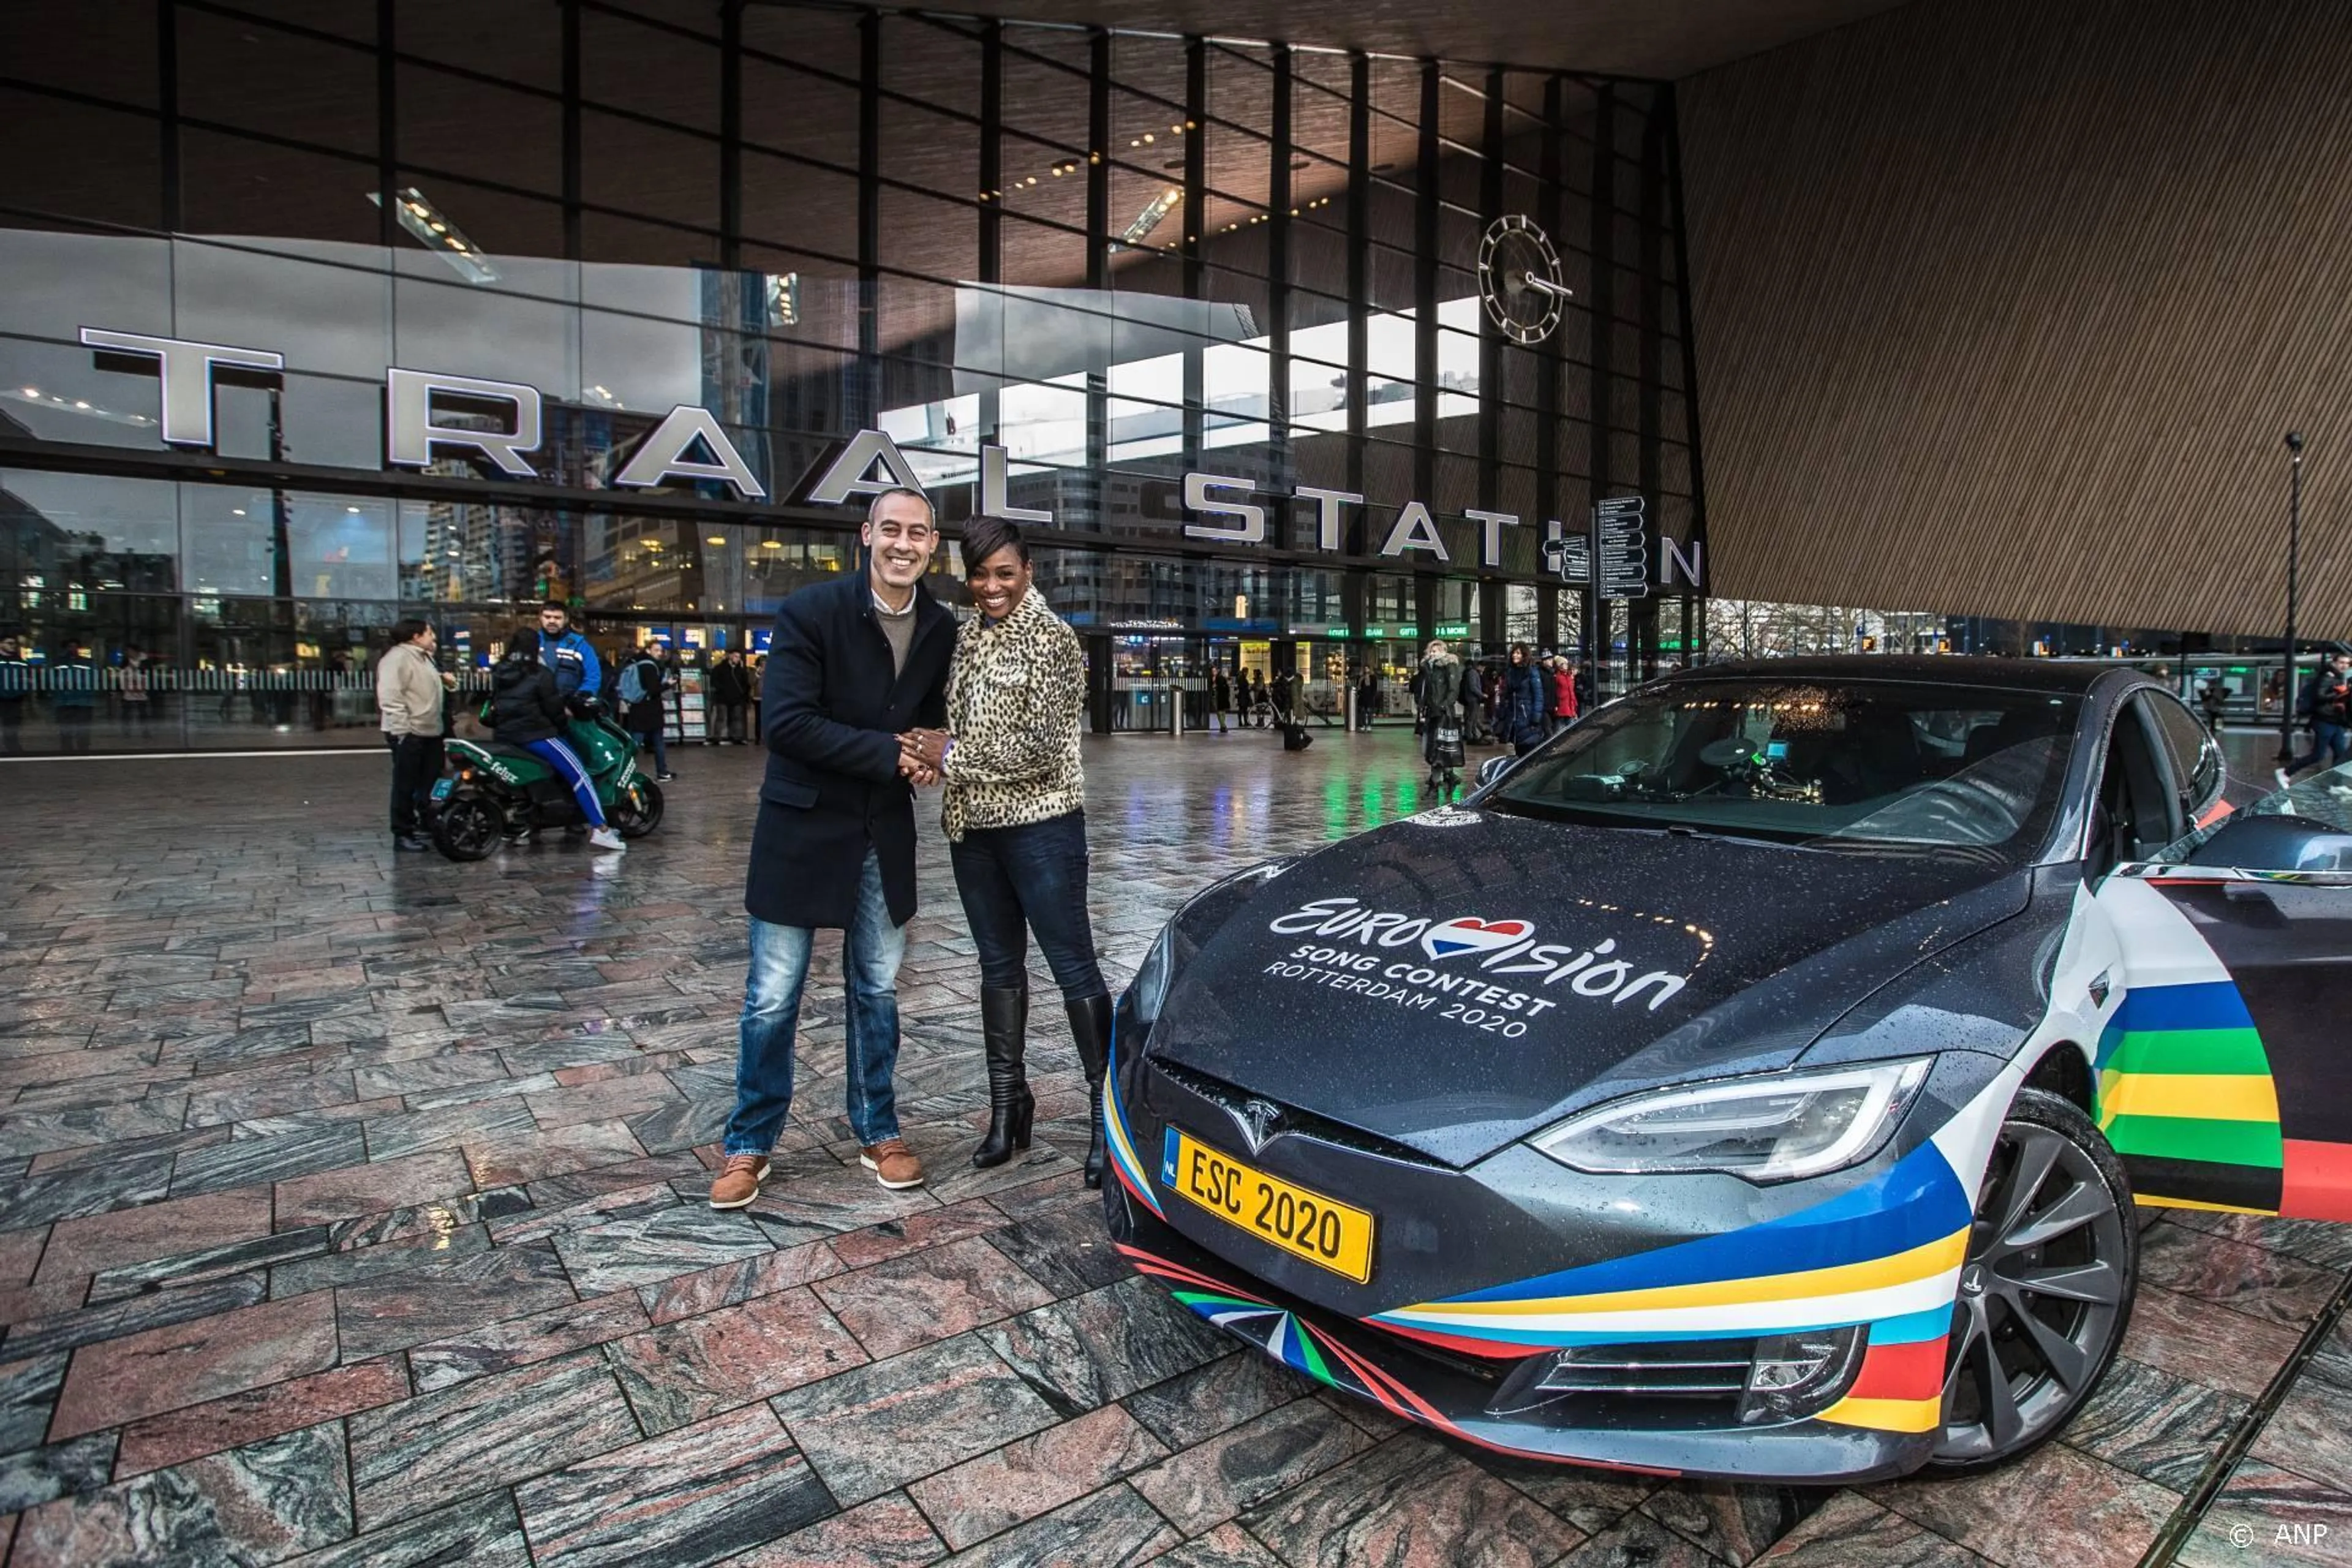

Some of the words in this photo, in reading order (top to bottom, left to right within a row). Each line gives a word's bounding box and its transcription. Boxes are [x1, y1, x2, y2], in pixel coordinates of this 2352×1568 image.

[1184, 472, 1700, 587] STATIN
[1263, 960, 1439, 1011] ROTTERDAM
[1439, 1003, 1528, 1039] 2020
[1289, 944, 1381, 972] SONG
[1382, 963, 1556, 1017] CONTEST
[1164, 1160, 1177, 1178] NL
[1190, 1148, 1242, 1215] ESC
[1254, 1182, 1342, 1259] 2020
